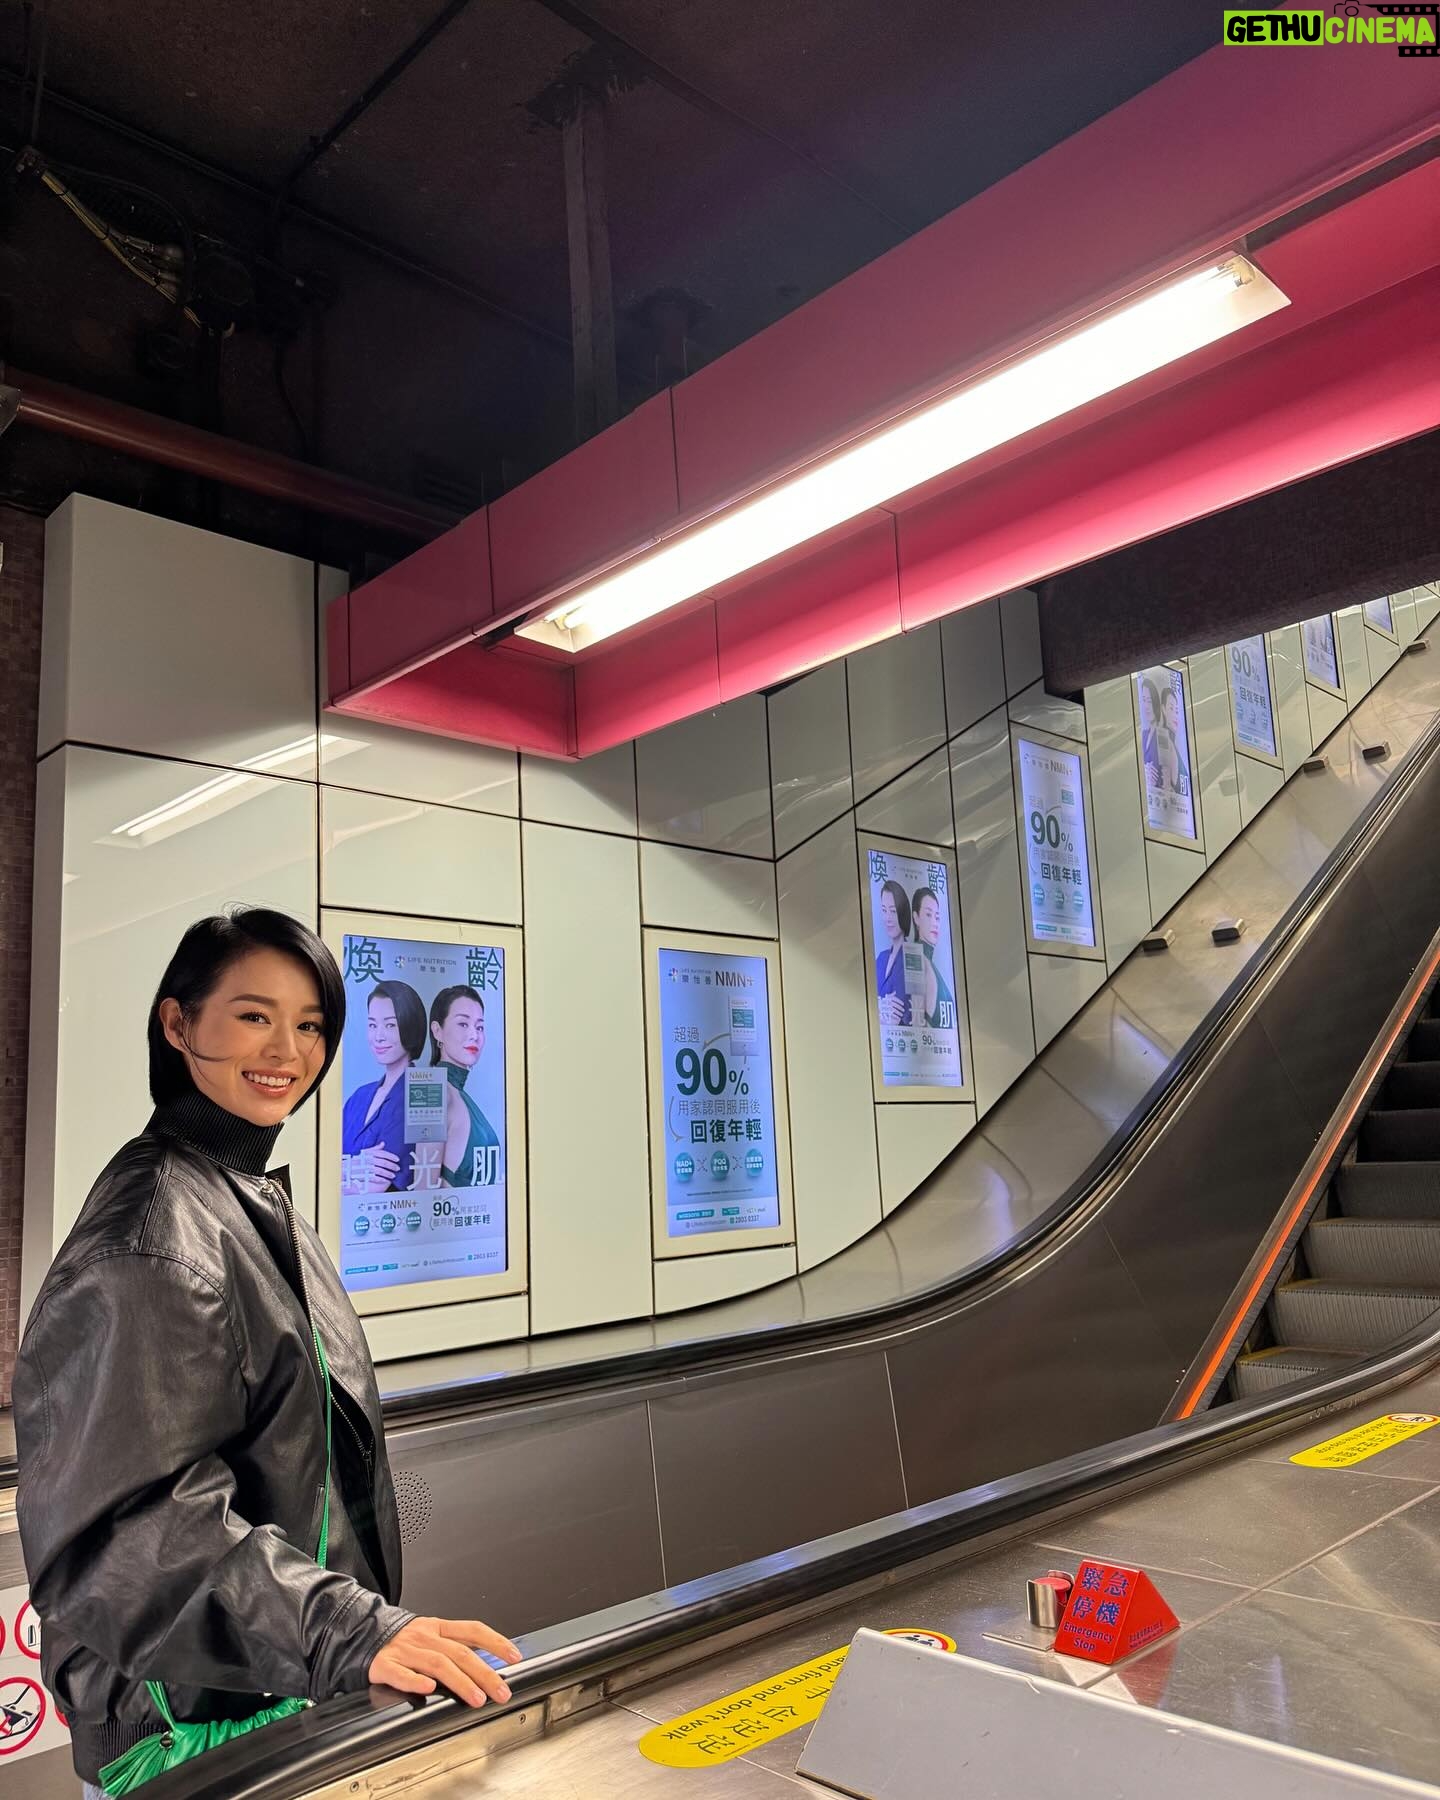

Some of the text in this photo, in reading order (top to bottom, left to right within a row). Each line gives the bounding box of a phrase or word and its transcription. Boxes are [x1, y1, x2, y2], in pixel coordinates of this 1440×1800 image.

[1031, 811, 1073, 852] 90%
[343, 937, 503, 990] 煥 齡
[715, 970, 754, 988] NMN+
[673, 1026, 700, 1043] 超過
[675, 1047, 749, 1096] 90%
[678, 1098, 761, 1116] 用家認同服用後
[690, 1118, 762, 1144] 回復年輕
[407, 1146, 442, 1191] 光
[390, 1200, 418, 1210] NMN+
[1082, 1567, 1129, 1597] 緊急
[1072, 1595, 1120, 1626] 停機
[1063, 1622, 1113, 1643] Emergency
[1073, 1638, 1095, 1651] Stop
[784, 1670, 822, 1687] firm
[752, 1682, 786, 1702] and
[706, 1698, 753, 1720] don't
[662, 1719, 708, 1741] walk
